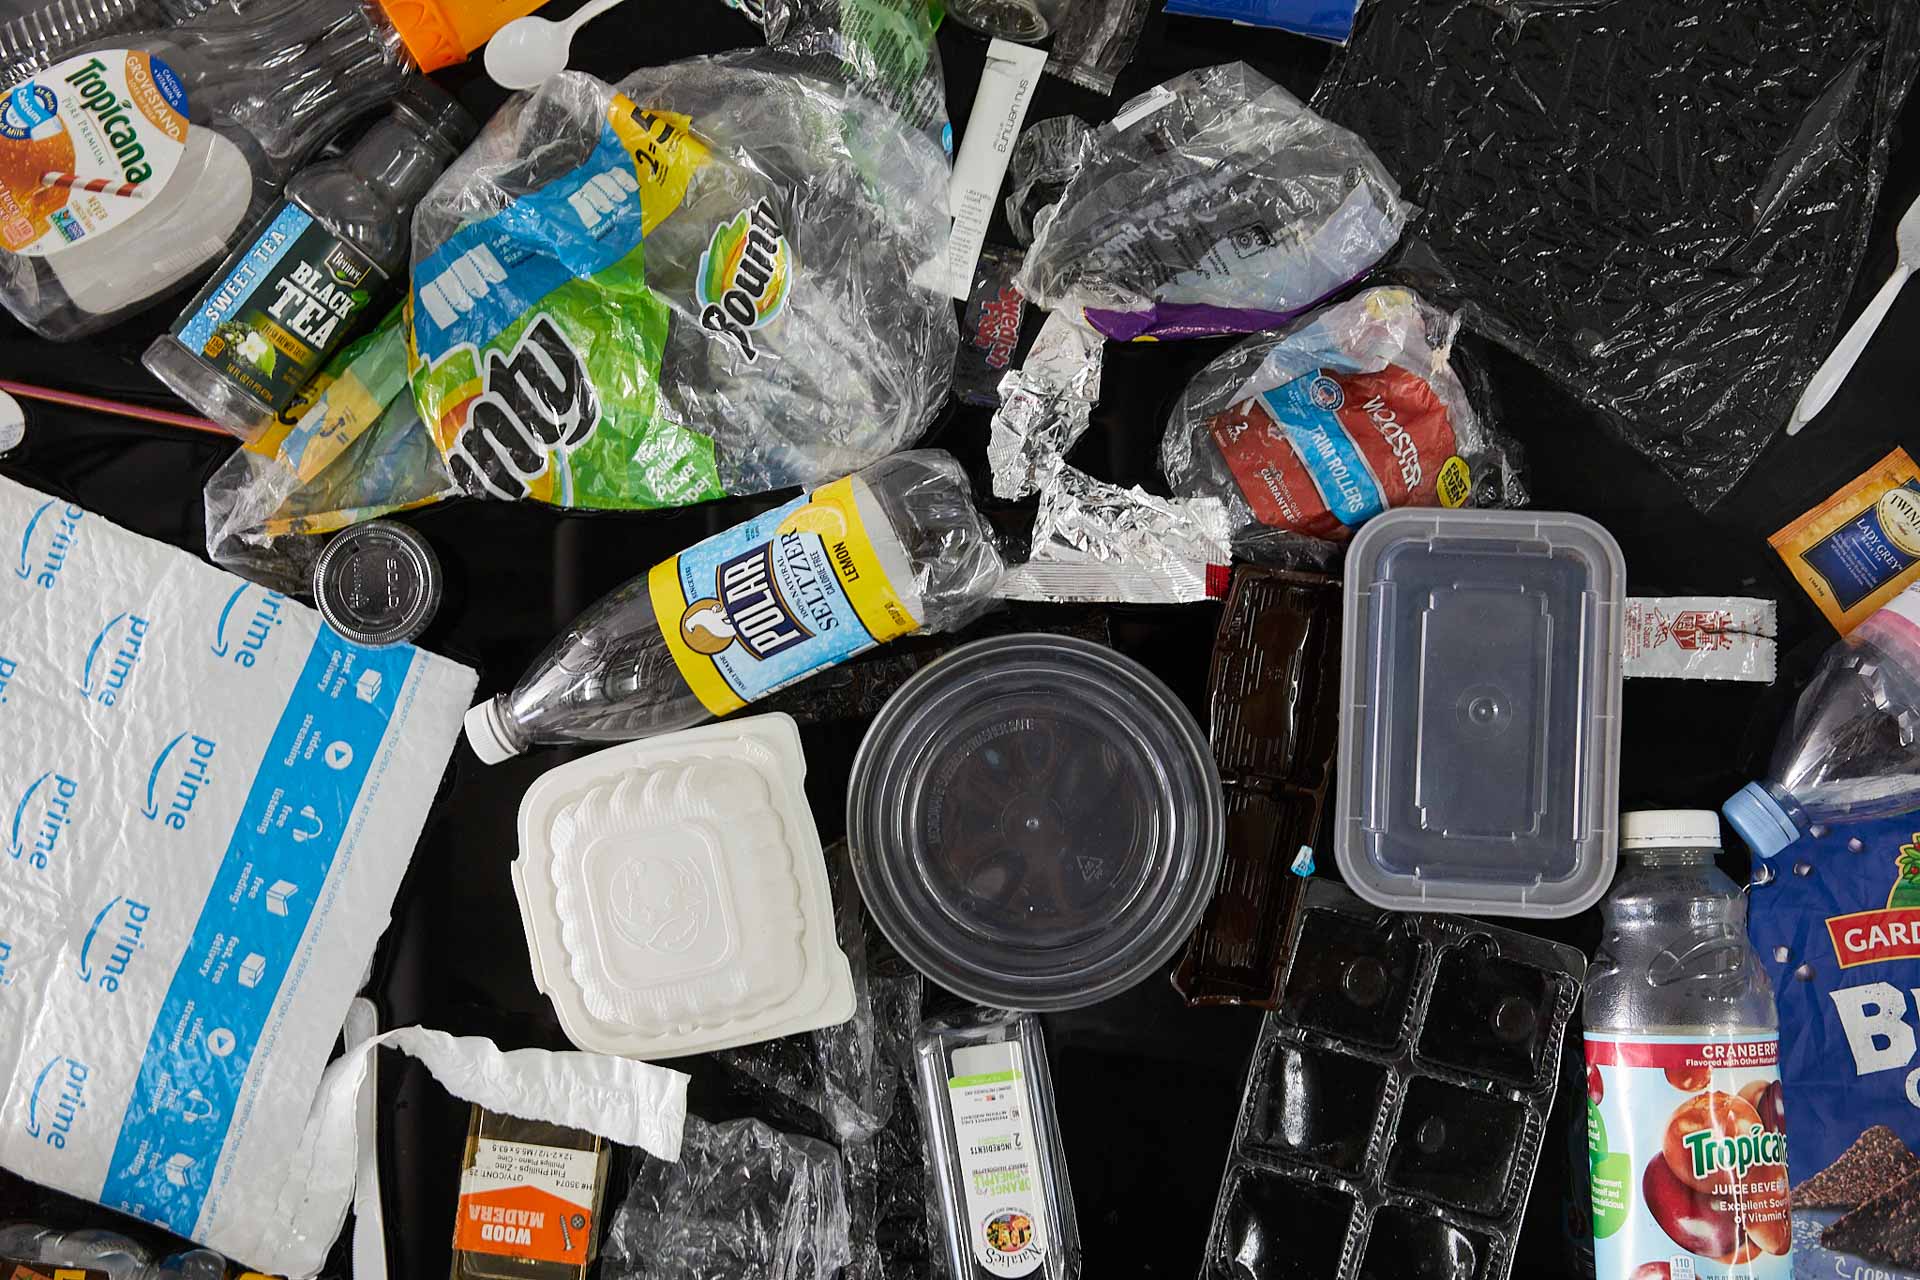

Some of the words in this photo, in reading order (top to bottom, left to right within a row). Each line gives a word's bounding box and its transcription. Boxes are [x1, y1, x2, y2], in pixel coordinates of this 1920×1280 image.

[127, 56, 180, 139] GROVESTAND
[162, 68, 183, 99] CALCIUM
[16, 88, 41, 124] Calcium
[65, 57, 152, 183] Tropicana
[78, 120, 104, 166] PREMIUM
[205, 264, 256, 321] SWEET
[253, 230, 286, 263] TEA
[290, 260, 356, 320] BLACK
[267, 277, 340, 350] TEA
[985, 286, 1025, 369] Swedish
[1361, 394, 1423, 493] WOOSTER
[1307, 423, 1336, 464] TRIM
[1325, 456, 1367, 514] ROLLERS
[1446, 462, 1470, 493] FAST
[1856, 517, 1879, 548] LADY
[778, 556, 801, 602] NATURAL
[780, 528, 840, 632] SELTZER
[809, 550, 836, 595] CALORIE-FREE
[832, 541, 860, 583] LEMON
[724, 551, 800, 655] POLAR
[1643, 626, 1654, 649] Sauce
[98, 614, 150, 707] prime
[317, 650, 343, 693] delivery
[330, 679, 347, 699] free
[284, 713, 314, 768] streaming
[304, 731, 322, 760] video
[165, 735, 217, 831] prime
[29, 774, 78, 871] prime
[256, 787, 285, 835] listening
[278, 804, 293, 828] free
[229, 861, 253, 904] reading
[248, 876, 265, 899] free
[100, 899, 152, 995] prime
[199, 932, 225, 977] delivery
[212, 961, 229, 984] free
[276, 957, 309, 1019] PERFORATION
[167, 1000, 195, 1052] streaming
[187, 1016, 204, 1047] video
[271, 1020, 281, 1033] TO
[1685, 1058, 1722, 1067] Flavored
[1740, 1057, 1758, 1066] Other
[1702, 1044, 1778, 1059] CRANBERR
[47, 1058, 91, 1150] prime
[130, 1139, 150, 1177] reading
[494, 1162, 512, 1170] Zinc
[519, 1164, 548, 1175] Phillips
[970, 1142, 1012, 1155] INGREDIENTS
[550, 1168, 565, 1177] Flat
[1711, 1183, 1749, 1195] JUICE
[469, 1204, 545, 1229] MADERA
[1720, 1200, 1768, 1211] Excellent
[1748, 1211, 1782, 1223] Vitamin
[481, 1223, 532, 1247] WOOD
[1675, 1258, 1690, 1268] 110
